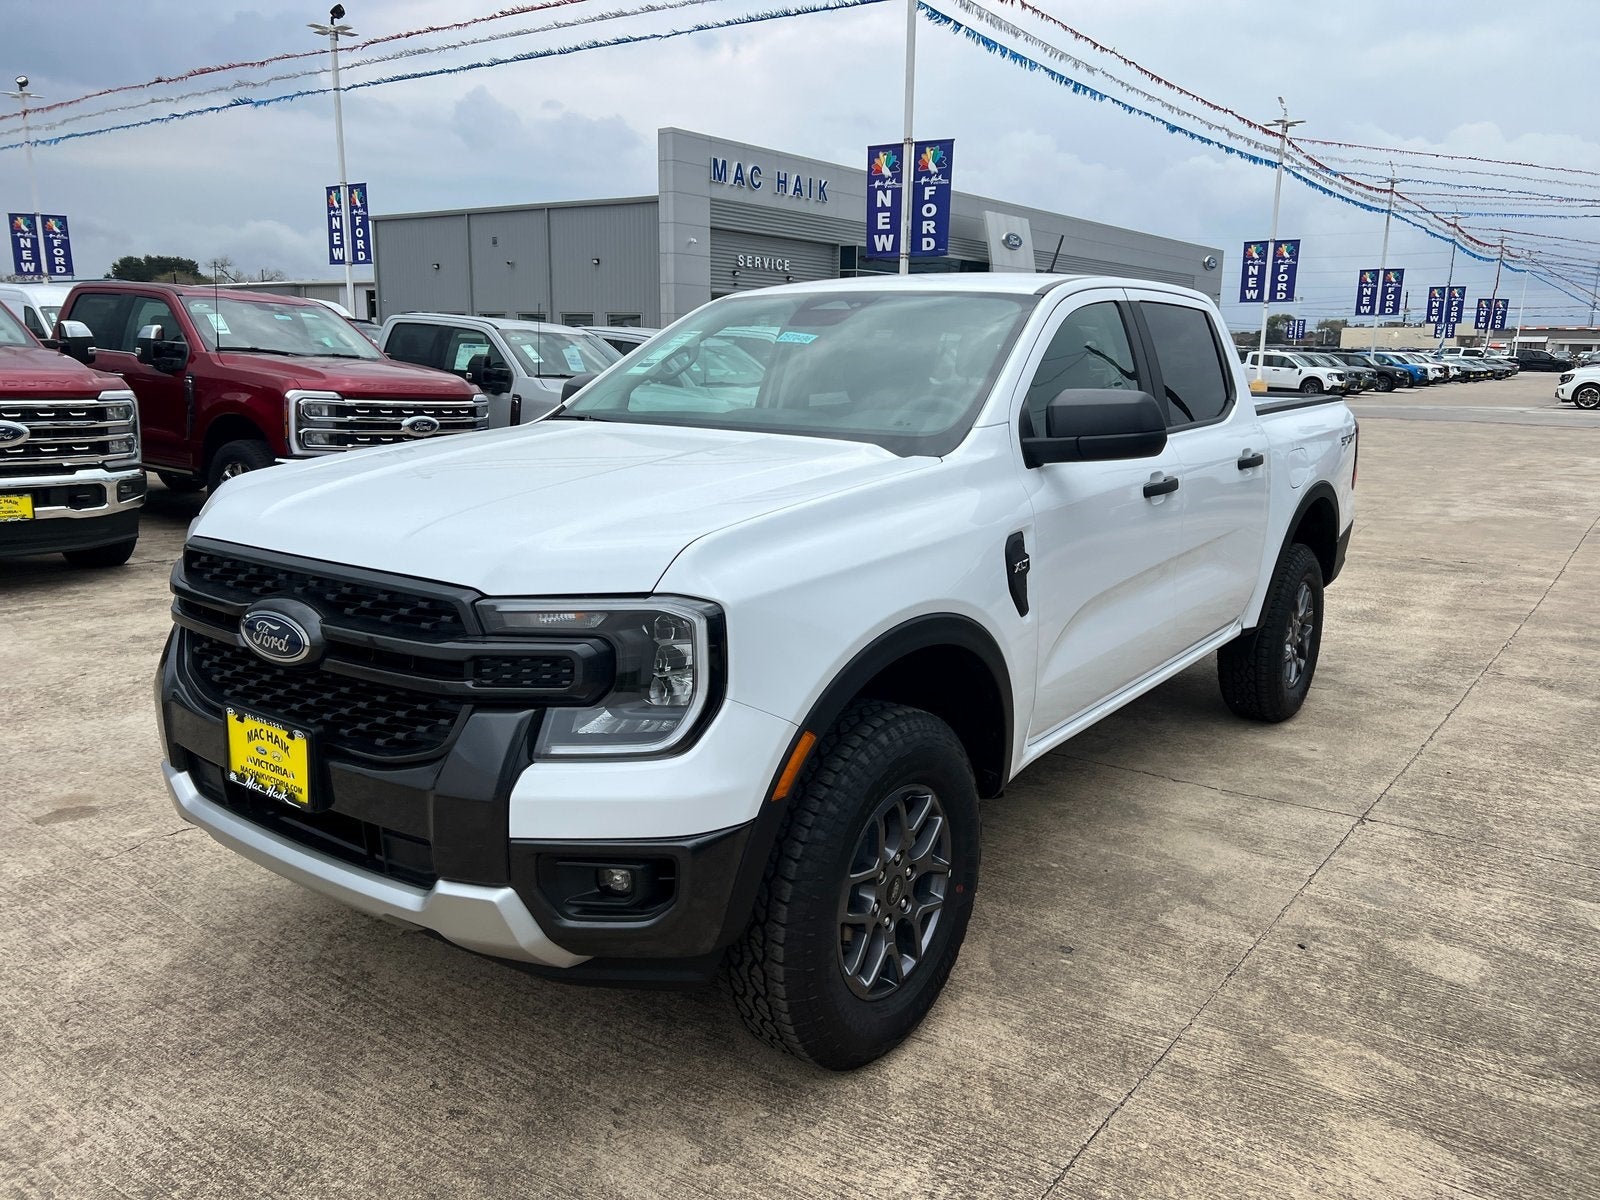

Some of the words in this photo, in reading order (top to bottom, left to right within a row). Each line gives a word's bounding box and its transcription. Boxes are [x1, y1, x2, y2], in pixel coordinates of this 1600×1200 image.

[710, 157, 762, 190] MAC
[775, 171, 828, 202] HAIK
[873, 190, 894, 252] NEW
[921, 186, 937, 251] FORD
[332, 216, 343, 260] NEW
[355, 216, 366, 261] FORD
[20, 238, 35, 272] NEW
[53, 239, 66, 273] FORD
[738, 254, 790, 271] SERVICE
[1245, 265, 1259, 300] NEW
[1276, 264, 1289, 300] FORD
[1360, 287, 1371, 314] NEW
[1384, 287, 1395, 314] FORD
[1430, 301, 1439, 322] NEW
[1450, 300, 1458, 322] FORD
[1478, 310, 1486, 328] NEW
[1494, 310, 1502, 329] FORD
[414, 421, 432, 431] Ford
[253, 620, 289, 652] Ford
[247, 728, 265, 744] MAC
[266, 730, 290, 758] HAIK
[253, 757, 289, 778] VICTORIA
[244, 776, 265, 794] Mac
[265, 785, 289, 800] Haik
